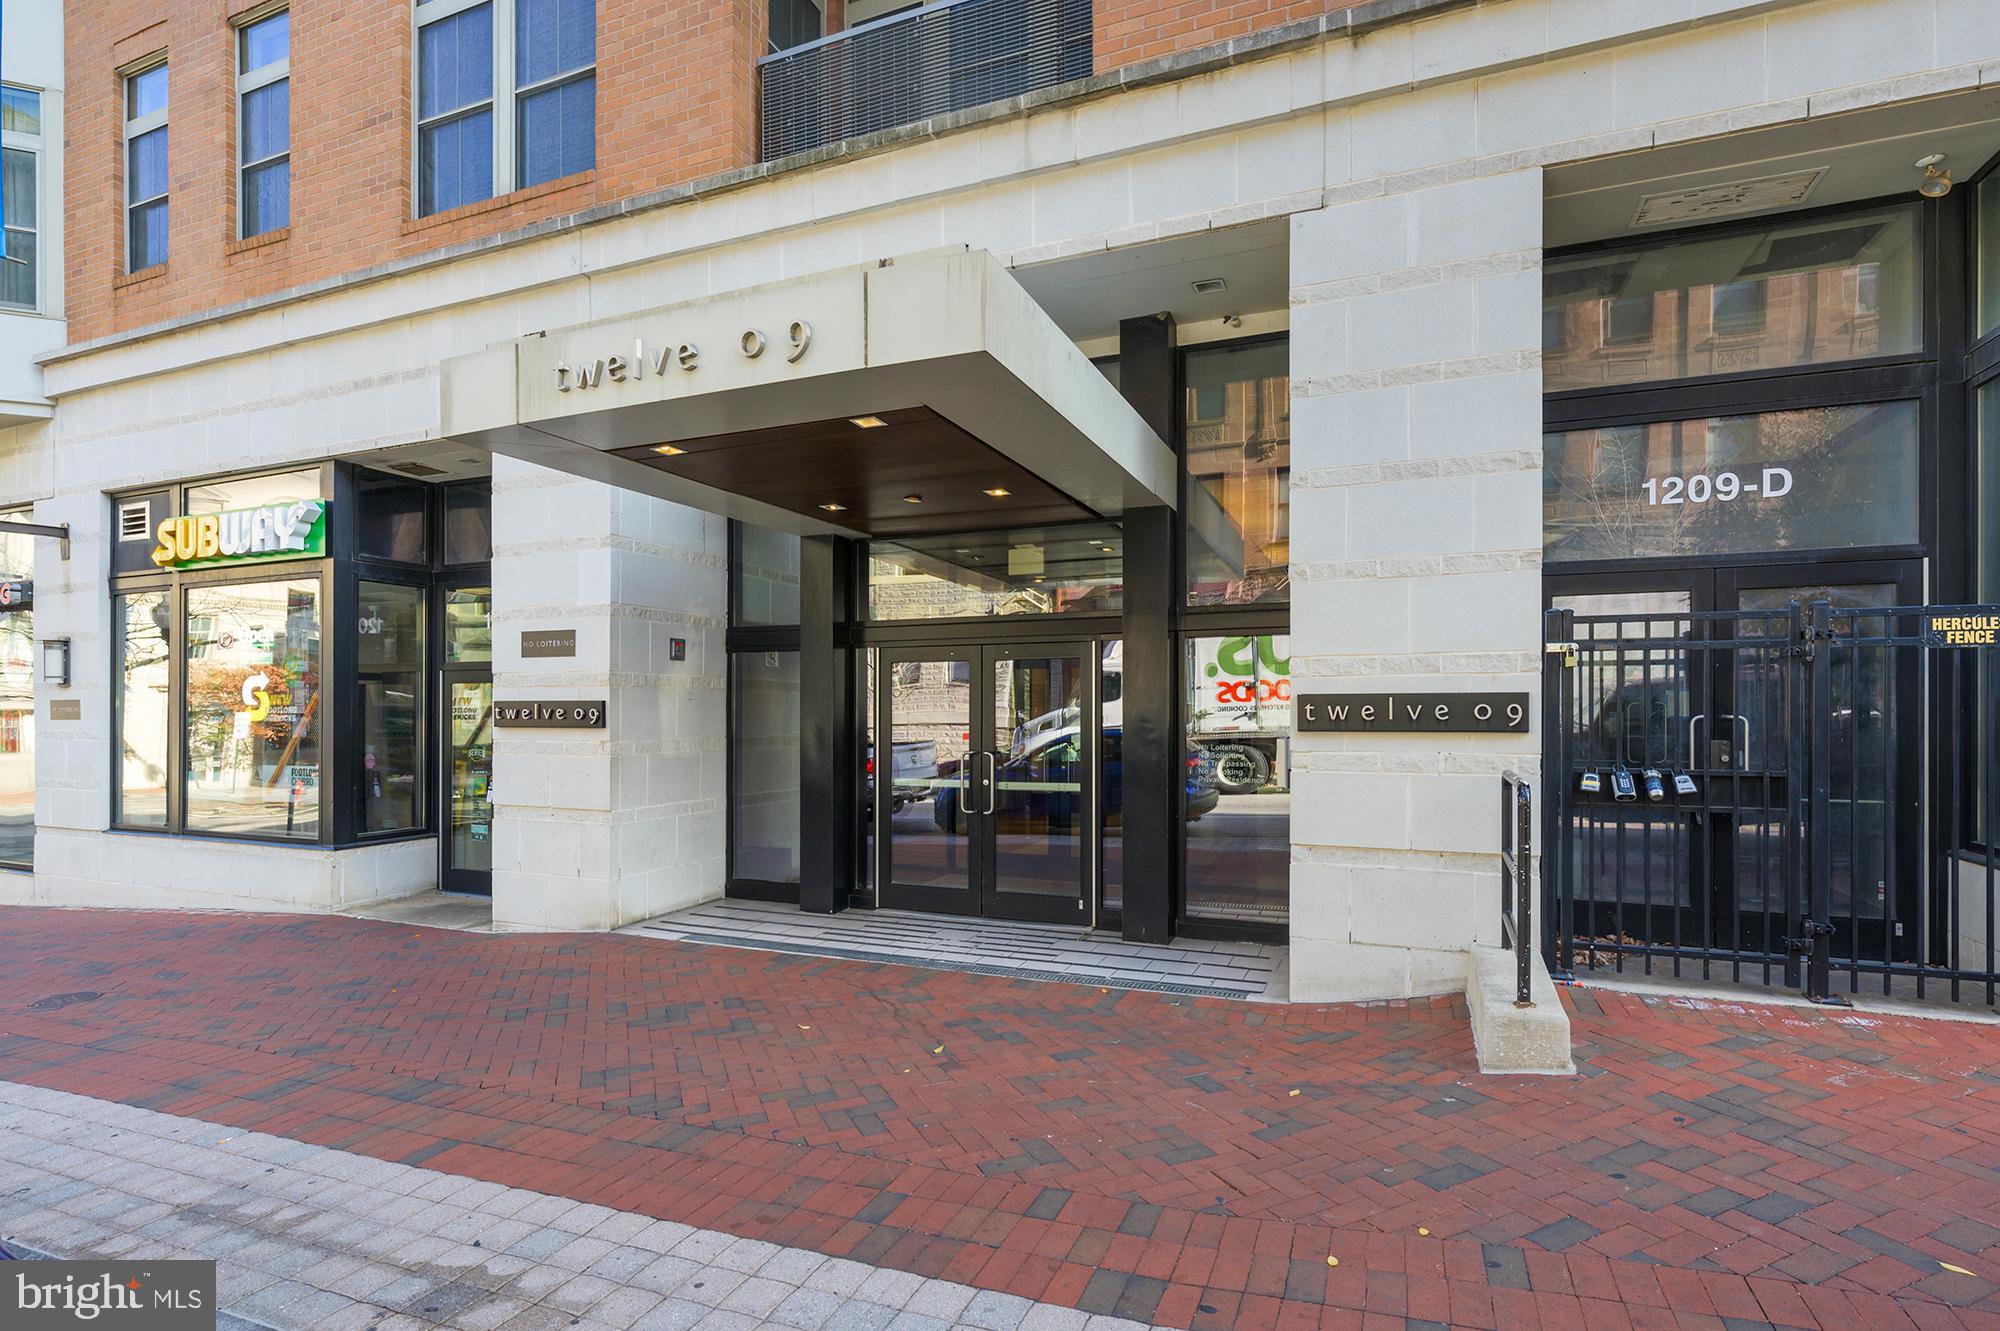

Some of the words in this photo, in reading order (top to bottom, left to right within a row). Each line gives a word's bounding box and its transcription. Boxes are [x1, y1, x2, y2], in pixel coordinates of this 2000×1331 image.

[553, 337, 698, 392] twelve
[1642, 467, 1793, 506] 1209-D
[151, 500, 323, 567] SUBWAY
[1932, 616, 2000, 631] HERCULE
[536, 639, 575, 648] LOITERING
[1946, 630, 1995, 644] FENCE
[495, 703, 566, 720] twelve
[1304, 696, 1449, 721] twelve
[1210, 744, 1244, 752] Loitering
[1210, 752, 1245, 760] Soliciting
[1210, 768, 1244, 776] Soking
